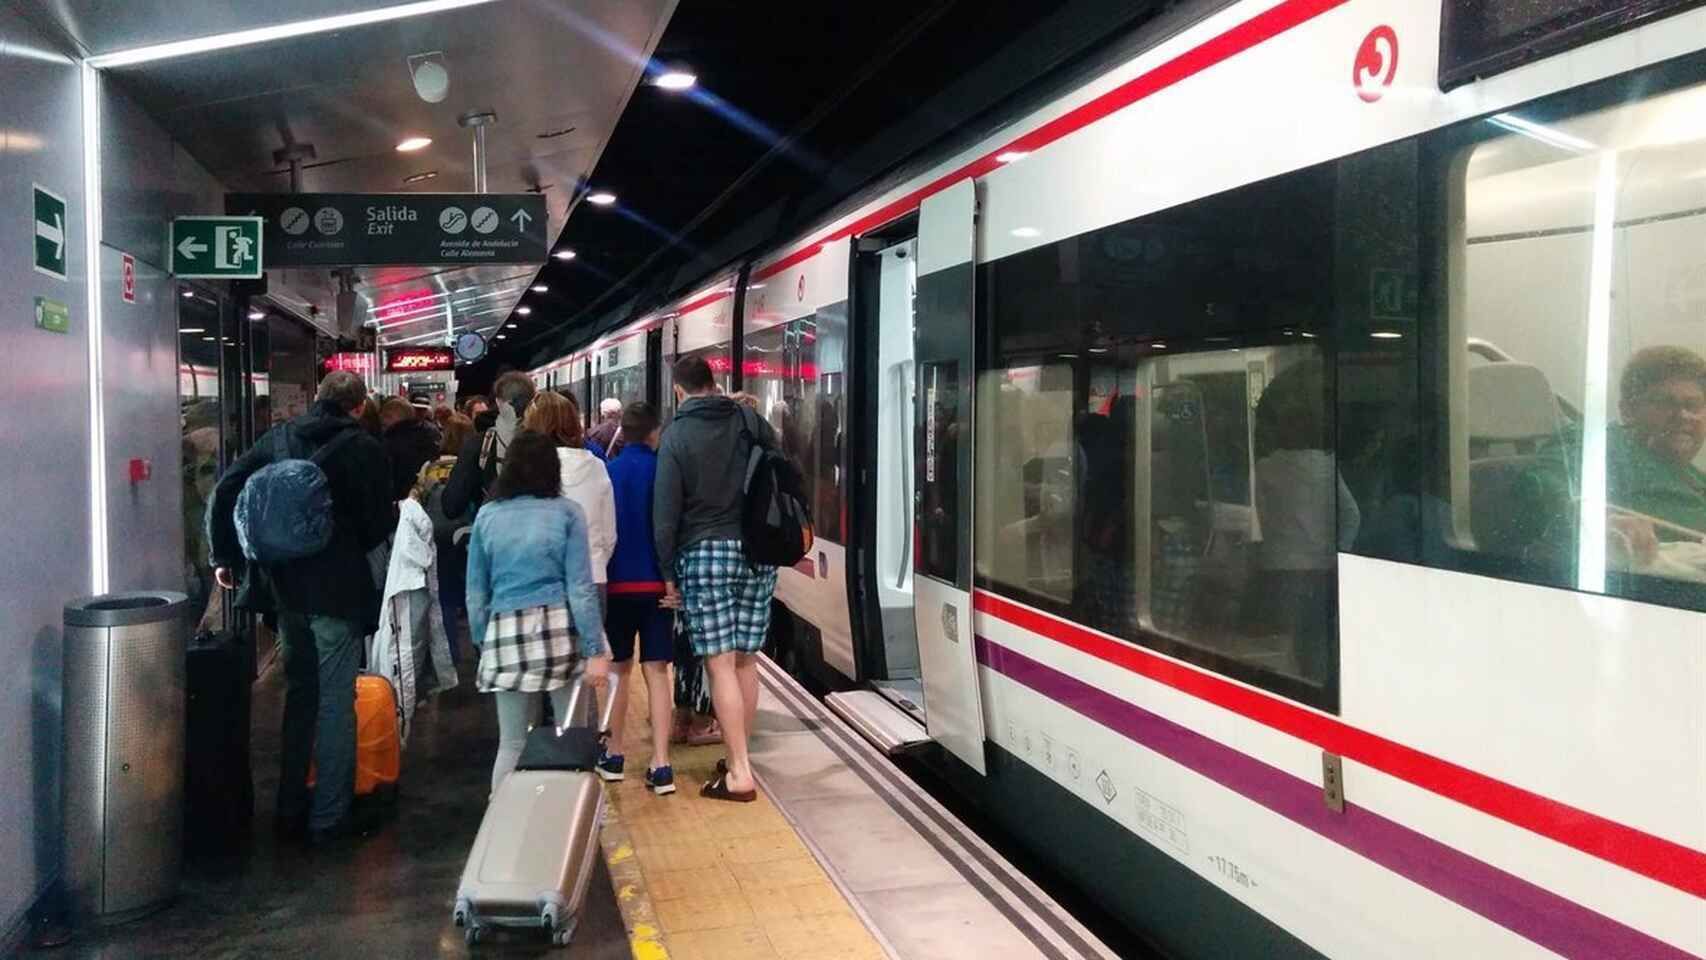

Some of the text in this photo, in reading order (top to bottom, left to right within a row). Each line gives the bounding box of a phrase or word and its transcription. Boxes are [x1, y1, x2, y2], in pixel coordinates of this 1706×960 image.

[366, 206, 417, 221] Salida
[367, 222, 394, 235] Exit
[472, 240, 481, 248] de
